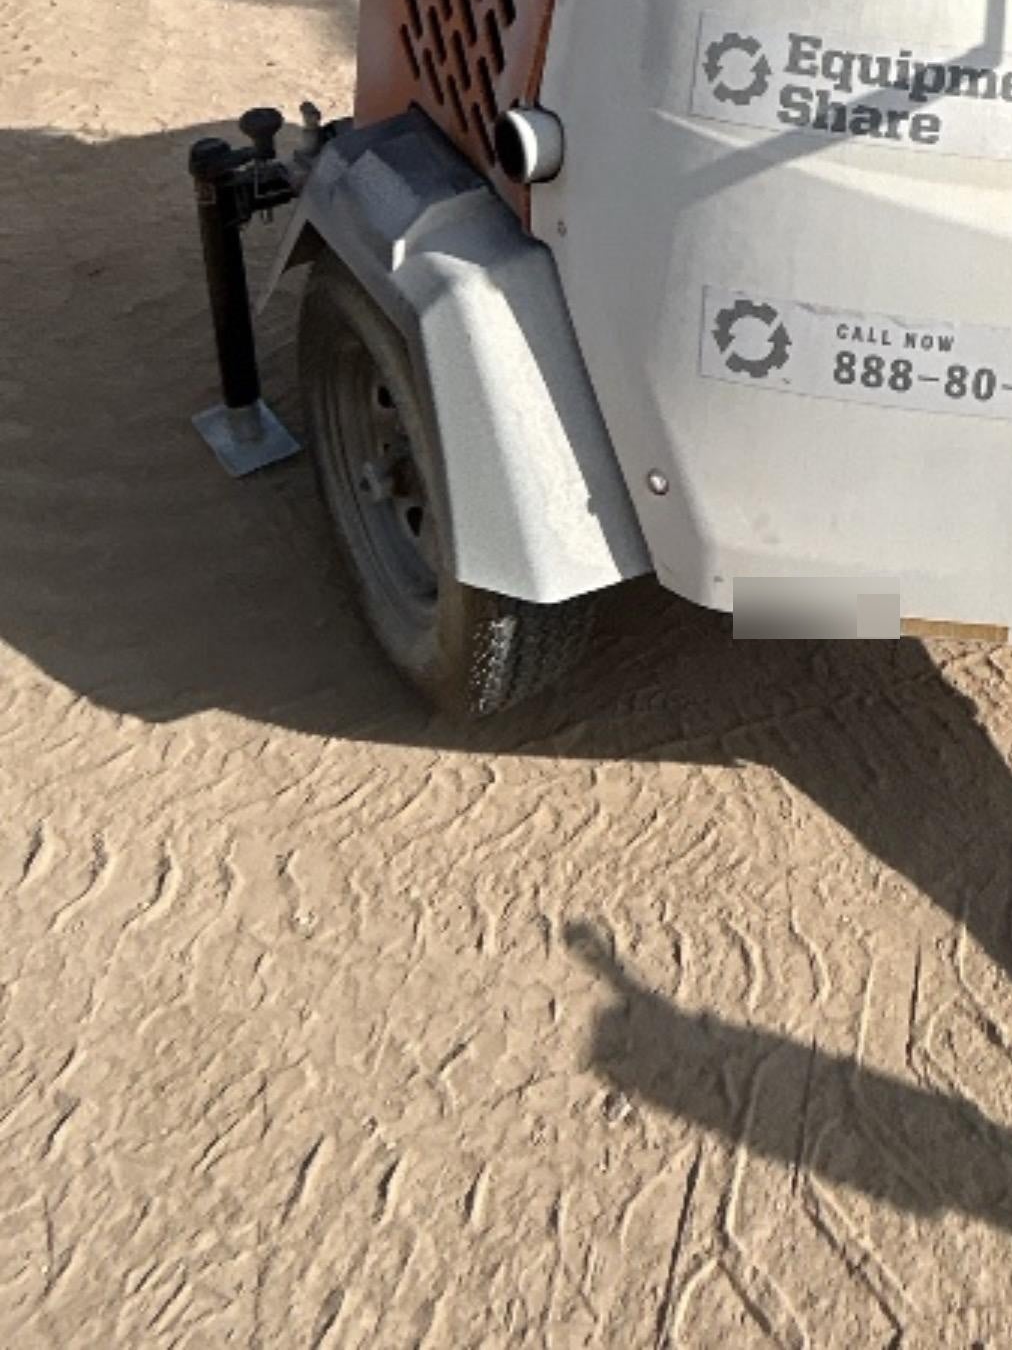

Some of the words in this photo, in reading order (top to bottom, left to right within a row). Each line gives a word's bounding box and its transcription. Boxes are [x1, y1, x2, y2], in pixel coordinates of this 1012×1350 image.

[777, 83, 942, 145] Share
[836, 323, 893, 347] CALL
[903, 332, 955, 352] NOW
